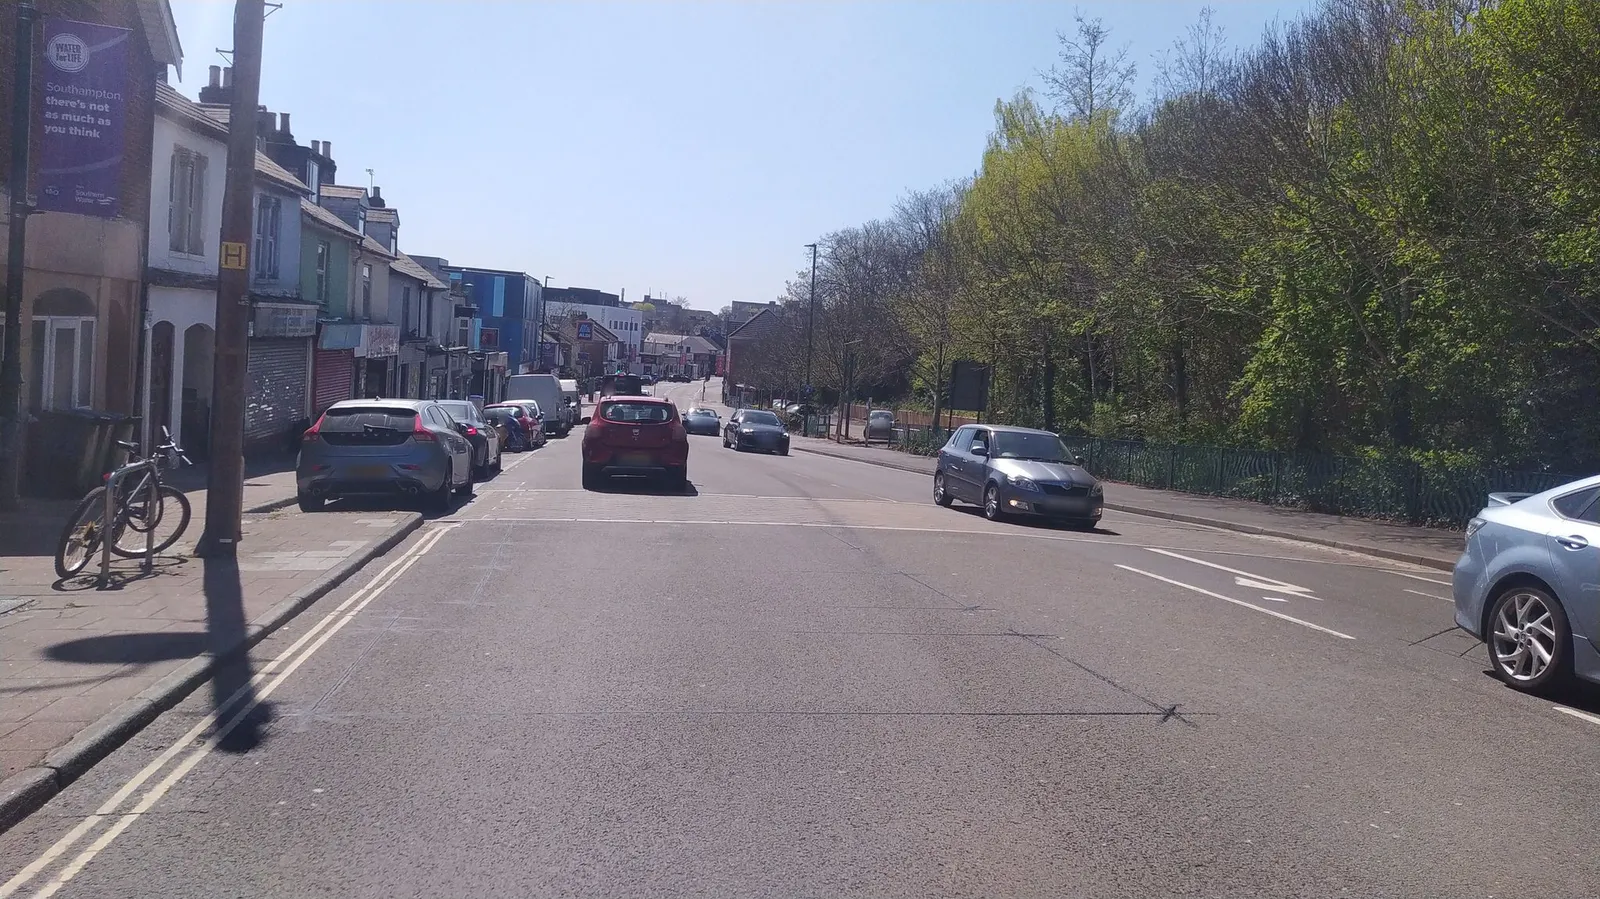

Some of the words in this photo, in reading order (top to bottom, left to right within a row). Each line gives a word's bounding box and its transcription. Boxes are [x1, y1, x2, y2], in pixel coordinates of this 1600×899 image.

[55, 43, 82, 54] WATER
[55, 52, 67, 61] for
[67, 53, 82, 63] LIFE
[46, 81, 124, 102] Southampton,
[45, 96, 86, 109] there's
[89, 103, 110, 112] not
[44, 111, 59, 120] as
[61, 112, 95, 124] much
[97, 117, 111, 126] as
[44, 124, 66, 134] you
[69, 126, 100, 138] think
[225, 244, 242, 267] H
